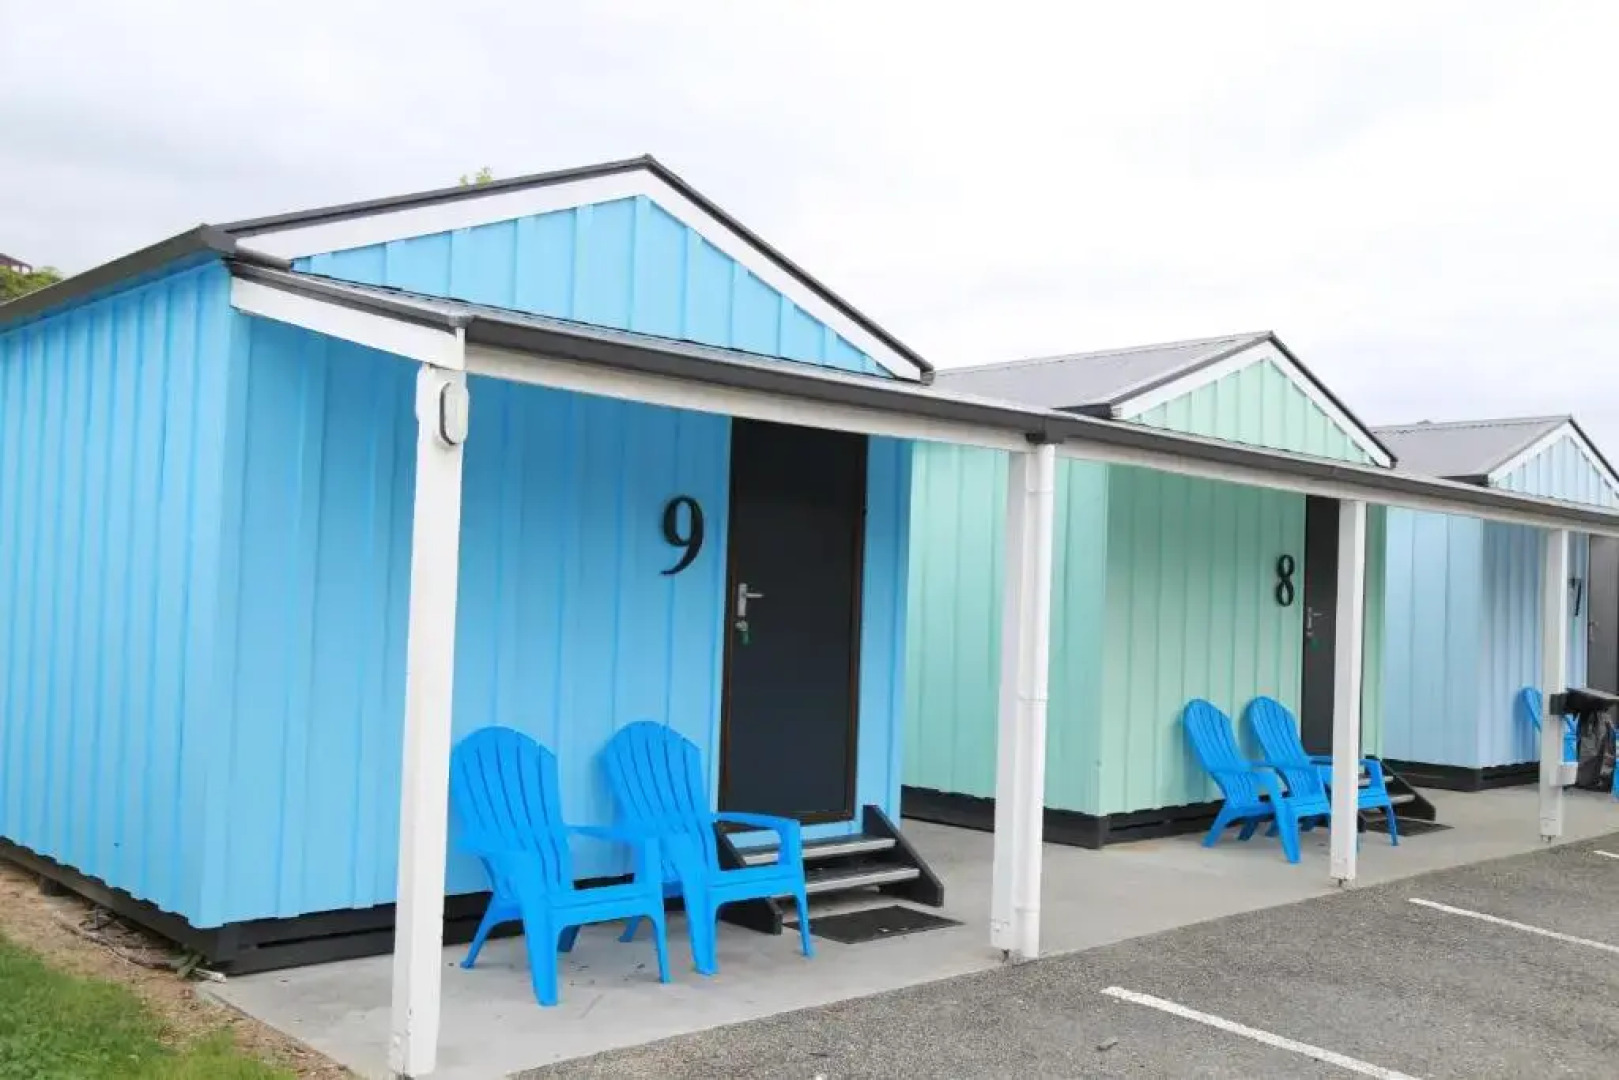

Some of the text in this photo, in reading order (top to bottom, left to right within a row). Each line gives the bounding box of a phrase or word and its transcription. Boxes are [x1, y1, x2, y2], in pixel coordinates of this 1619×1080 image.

[659, 494, 704, 575] 9
[1274, 553, 1296, 607] 8
[1569, 576, 1582, 617] 7
